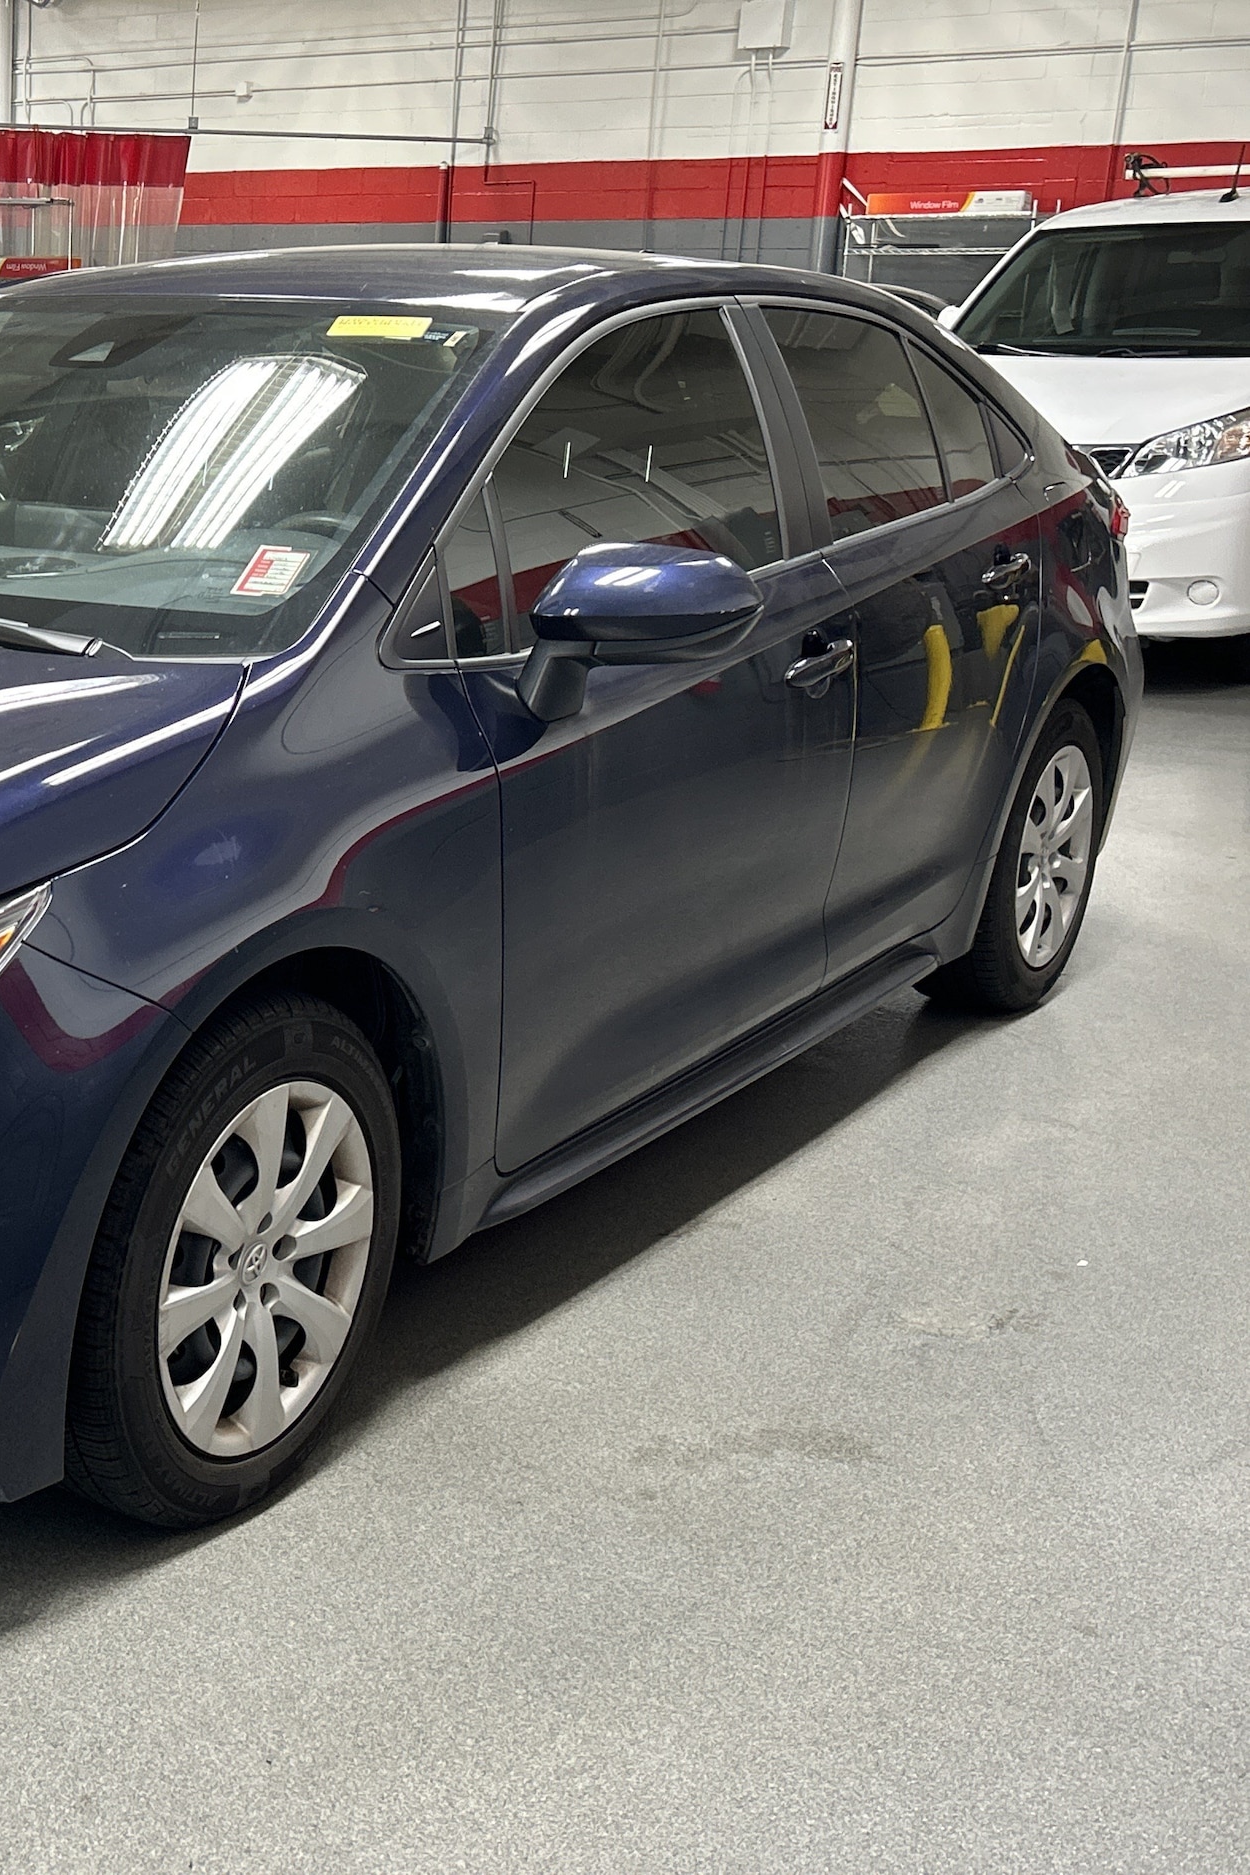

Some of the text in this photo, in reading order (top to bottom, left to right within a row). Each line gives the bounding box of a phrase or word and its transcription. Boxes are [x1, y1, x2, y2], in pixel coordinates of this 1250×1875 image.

[910, 200, 959, 209] Window Film
[6, 263, 47, 271] Window Film
[165, 1056, 257, 1179] GENERAL
